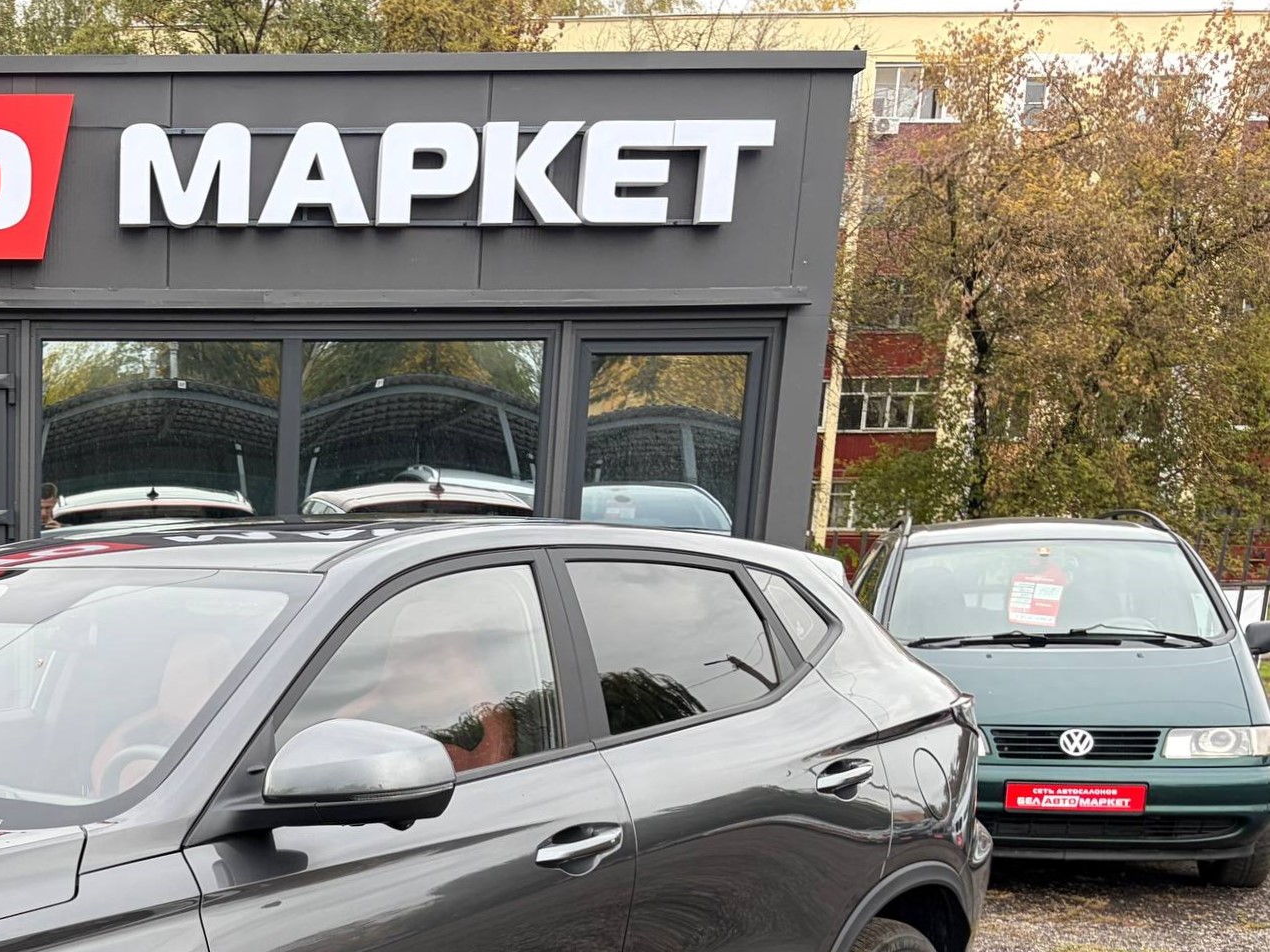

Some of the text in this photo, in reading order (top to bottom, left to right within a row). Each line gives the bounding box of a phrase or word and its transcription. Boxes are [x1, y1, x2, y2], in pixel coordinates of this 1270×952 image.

[119, 120, 776, 228] МАРКЕТ
[1017, 797, 1131, 807] БЕЛ АВТО МАРКЕТ
